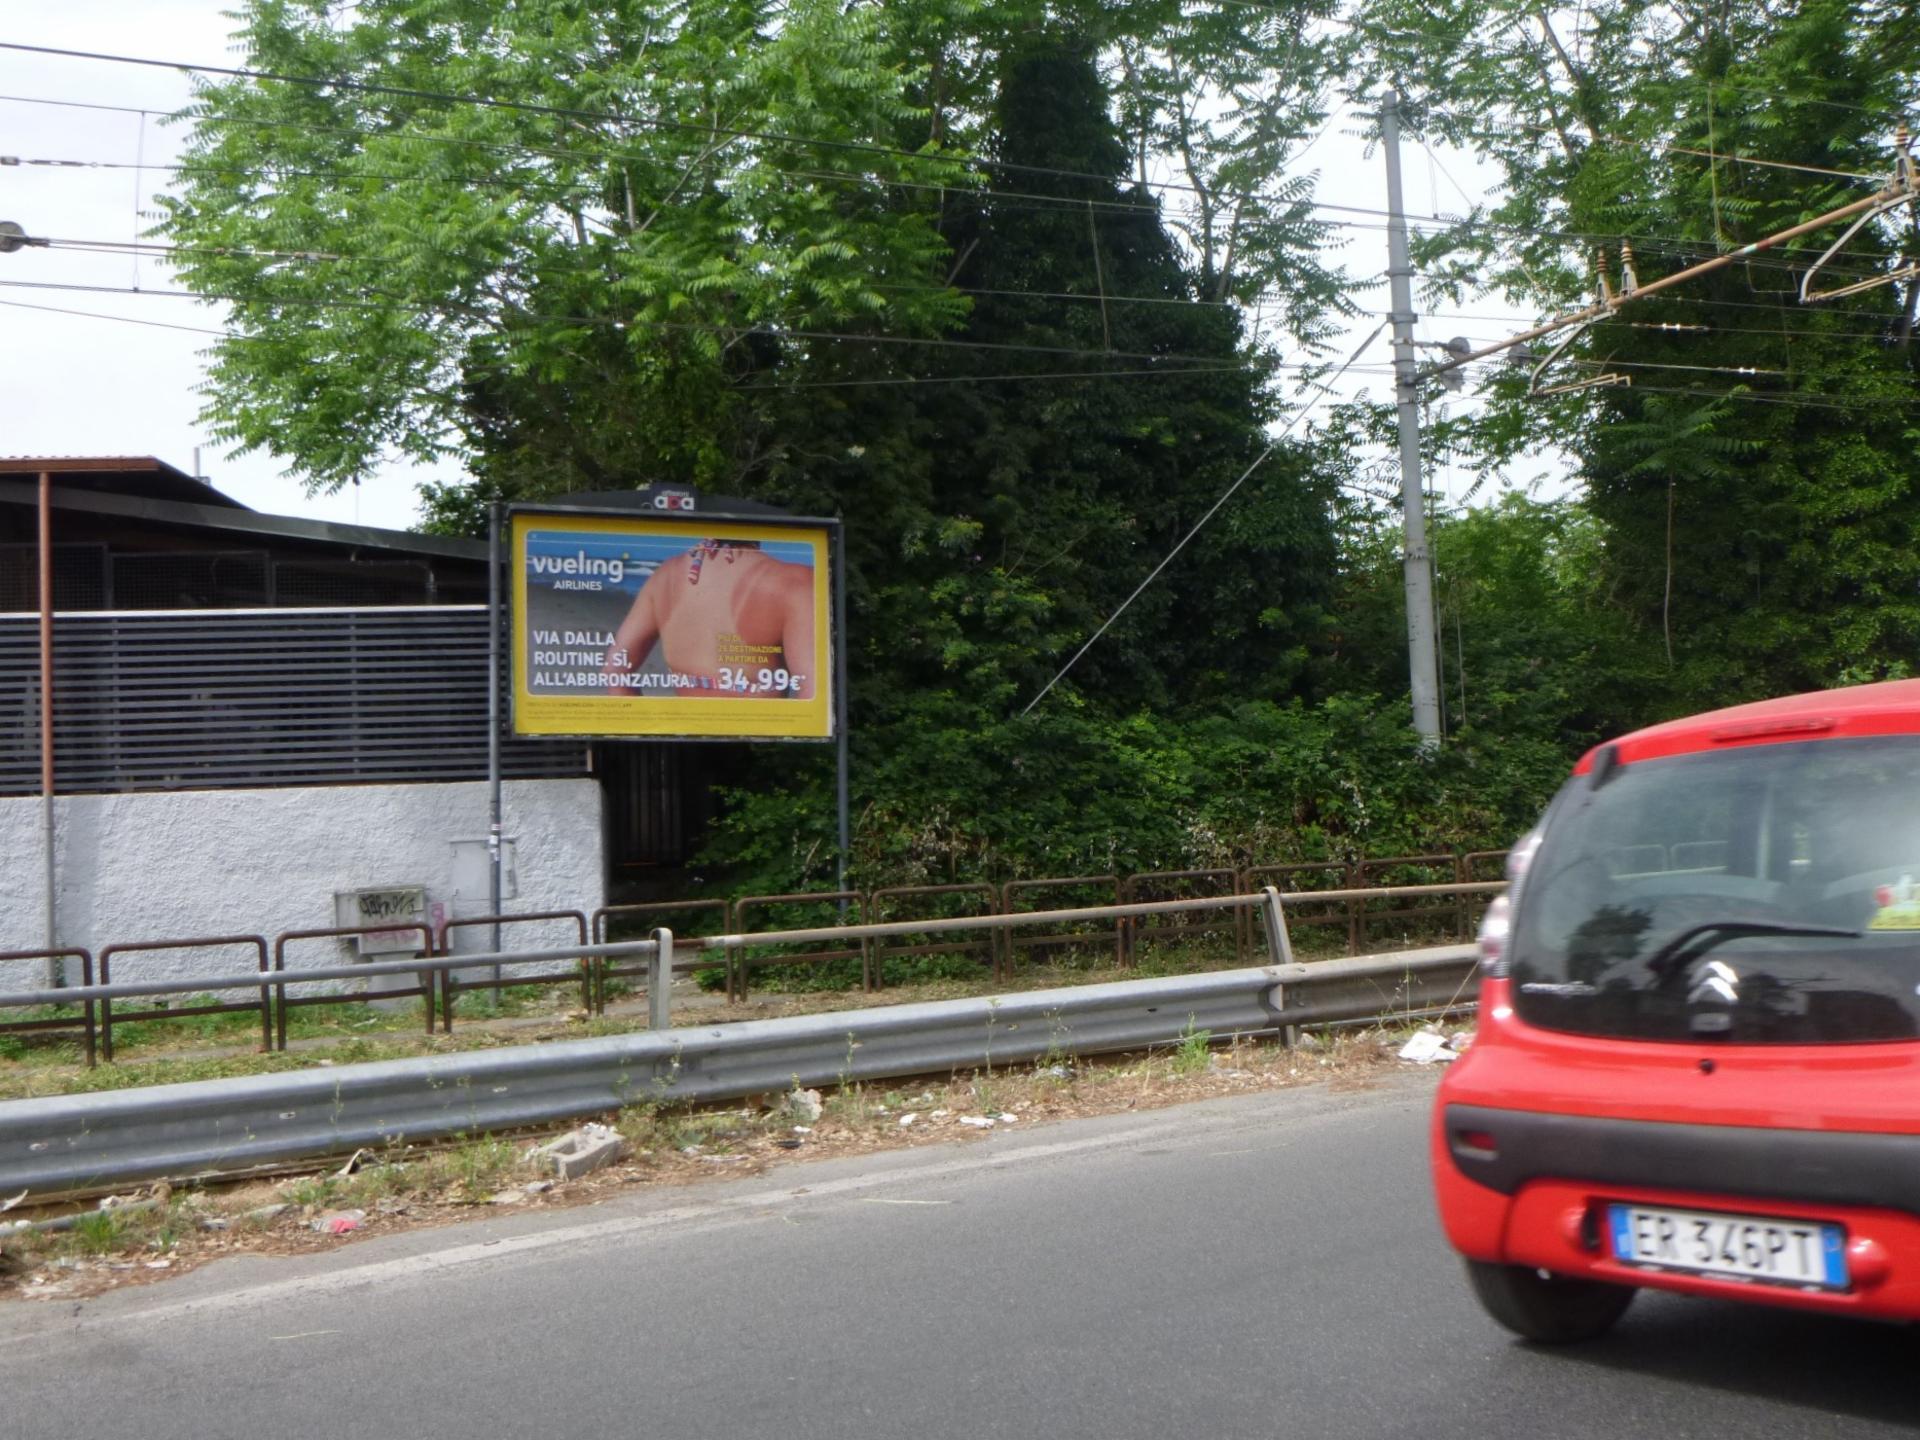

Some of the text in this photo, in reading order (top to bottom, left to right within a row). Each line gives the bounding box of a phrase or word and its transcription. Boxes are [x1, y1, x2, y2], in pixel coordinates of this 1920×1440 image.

[532, 550, 625, 583] vueling
[553, 580, 603, 591] AIRLINES
[533, 630, 616, 646] VIA DALLA
[534, 651, 609, 667] ROUTINE.
[758, 655, 769, 664] DA
[1635, 1214, 1812, 1276] ER 346PT
